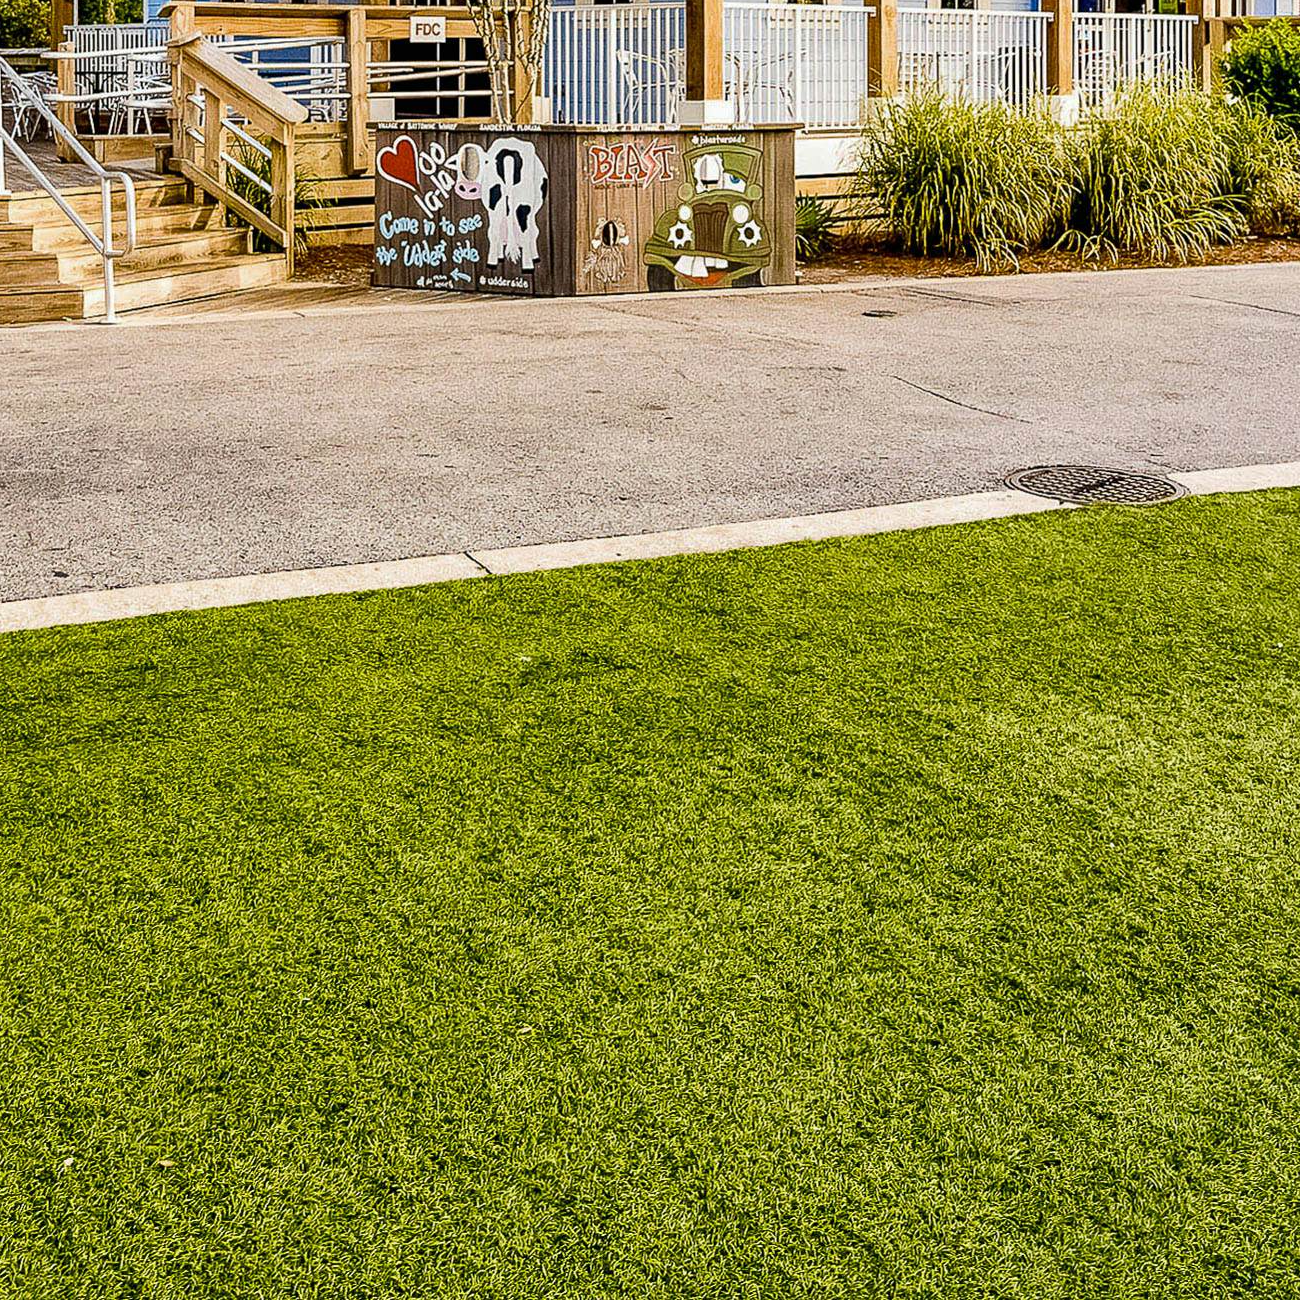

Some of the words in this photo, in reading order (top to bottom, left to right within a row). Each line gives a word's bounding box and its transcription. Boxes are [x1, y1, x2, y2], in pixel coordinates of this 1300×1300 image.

[415, 22, 441, 36] FDC
[589, 138, 676, 190] BLAST
[379, 210, 419, 240] Come
[423, 218, 436, 237] in
[439, 215, 456, 237] to
[458, 213, 483, 235] see
[375, 244, 398, 266] the
[452, 239, 481, 265] side
